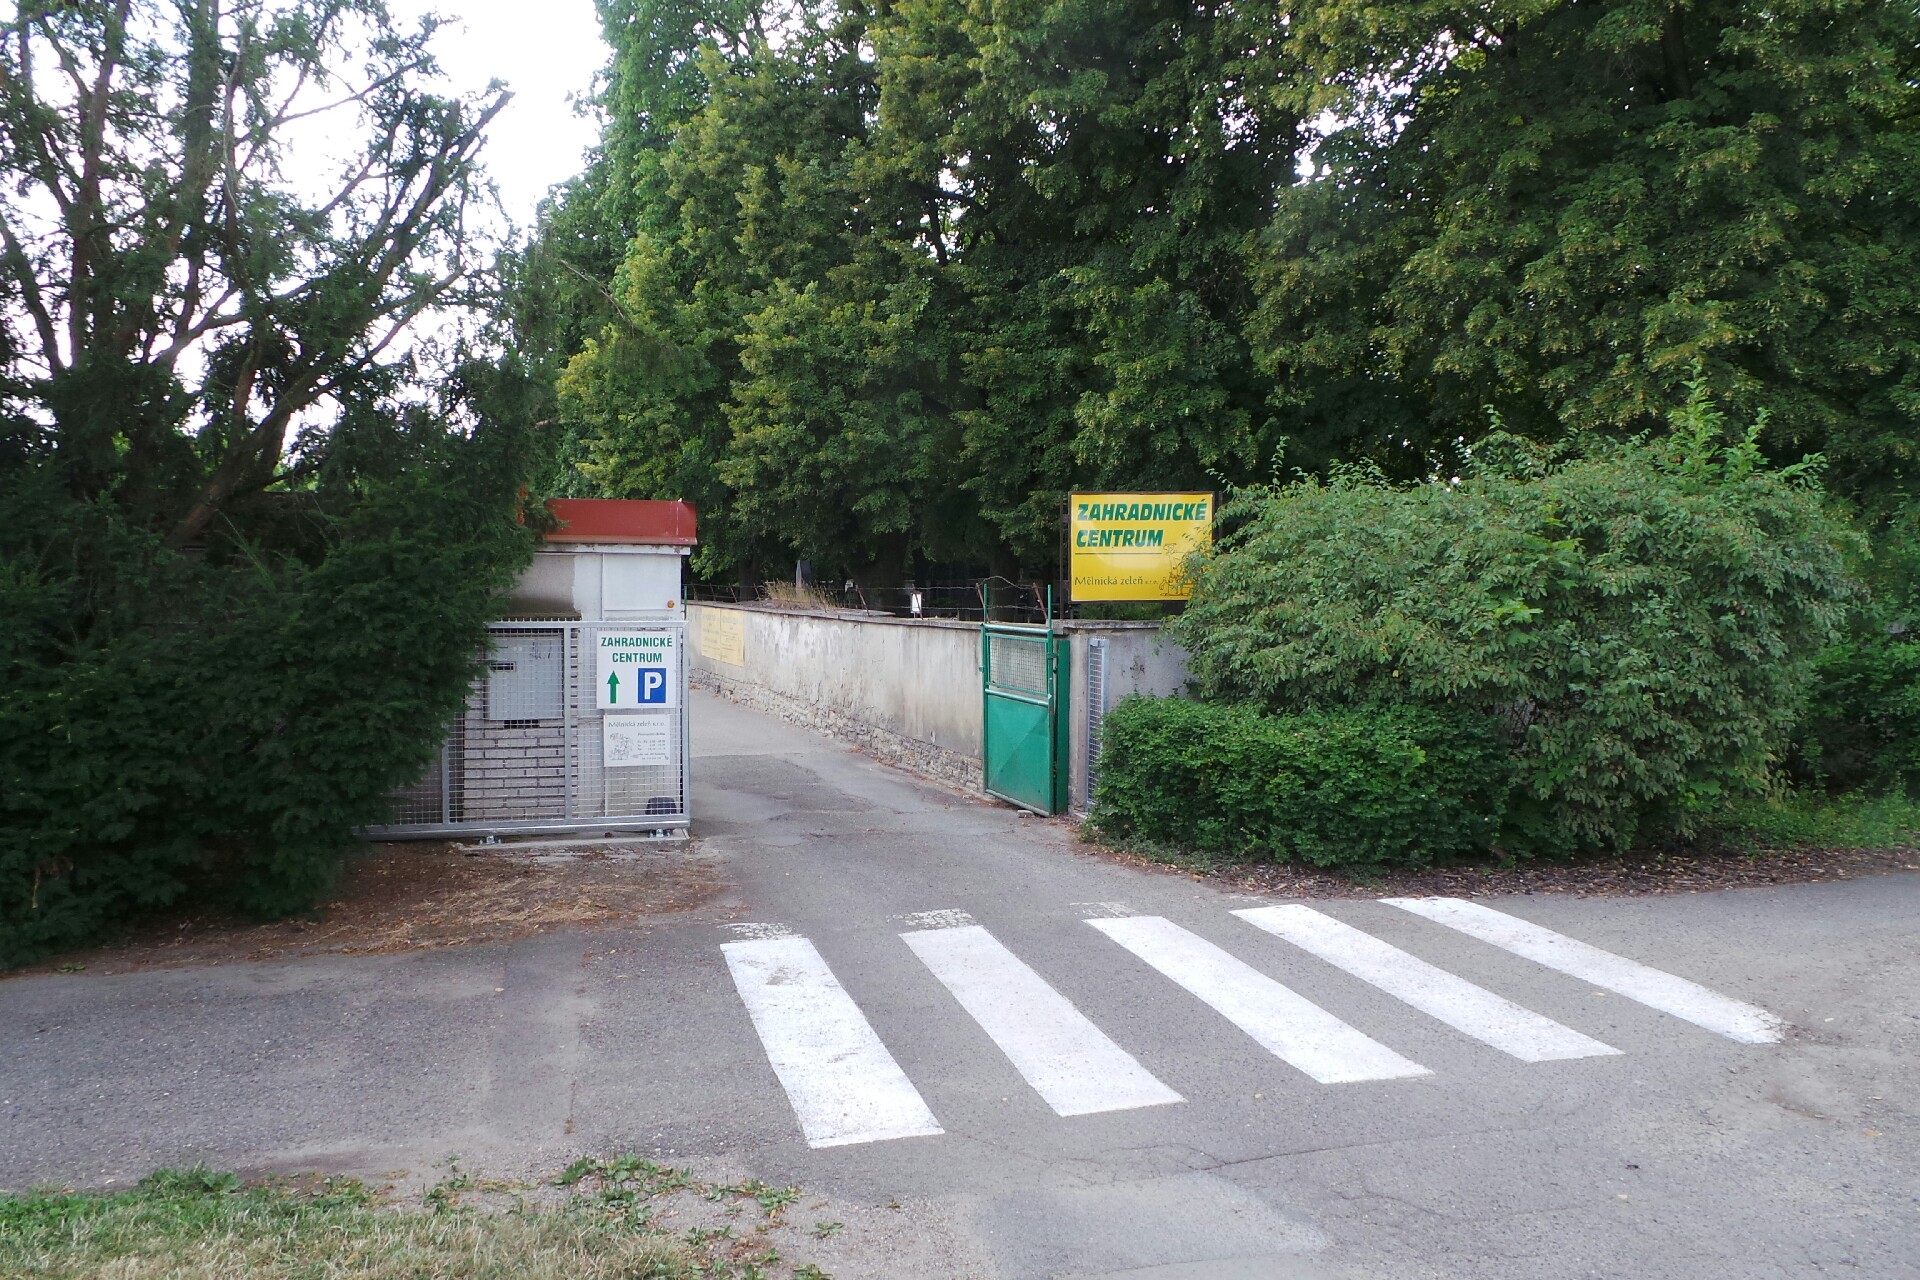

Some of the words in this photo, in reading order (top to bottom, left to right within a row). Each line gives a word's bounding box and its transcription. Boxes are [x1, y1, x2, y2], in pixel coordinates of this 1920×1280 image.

[1077, 498, 1207, 521] ZAHRADNICKÉ
[1076, 529, 1164, 548] CENTRUM
[1074, 576, 1117, 586] Mělnická
[1120, 576, 1143, 585] zeleň
[601, 634, 673, 647] ZAHRADNICKÉ
[612, 652, 662, 663] CENTRUM
[644, 671, 662, 700] P
